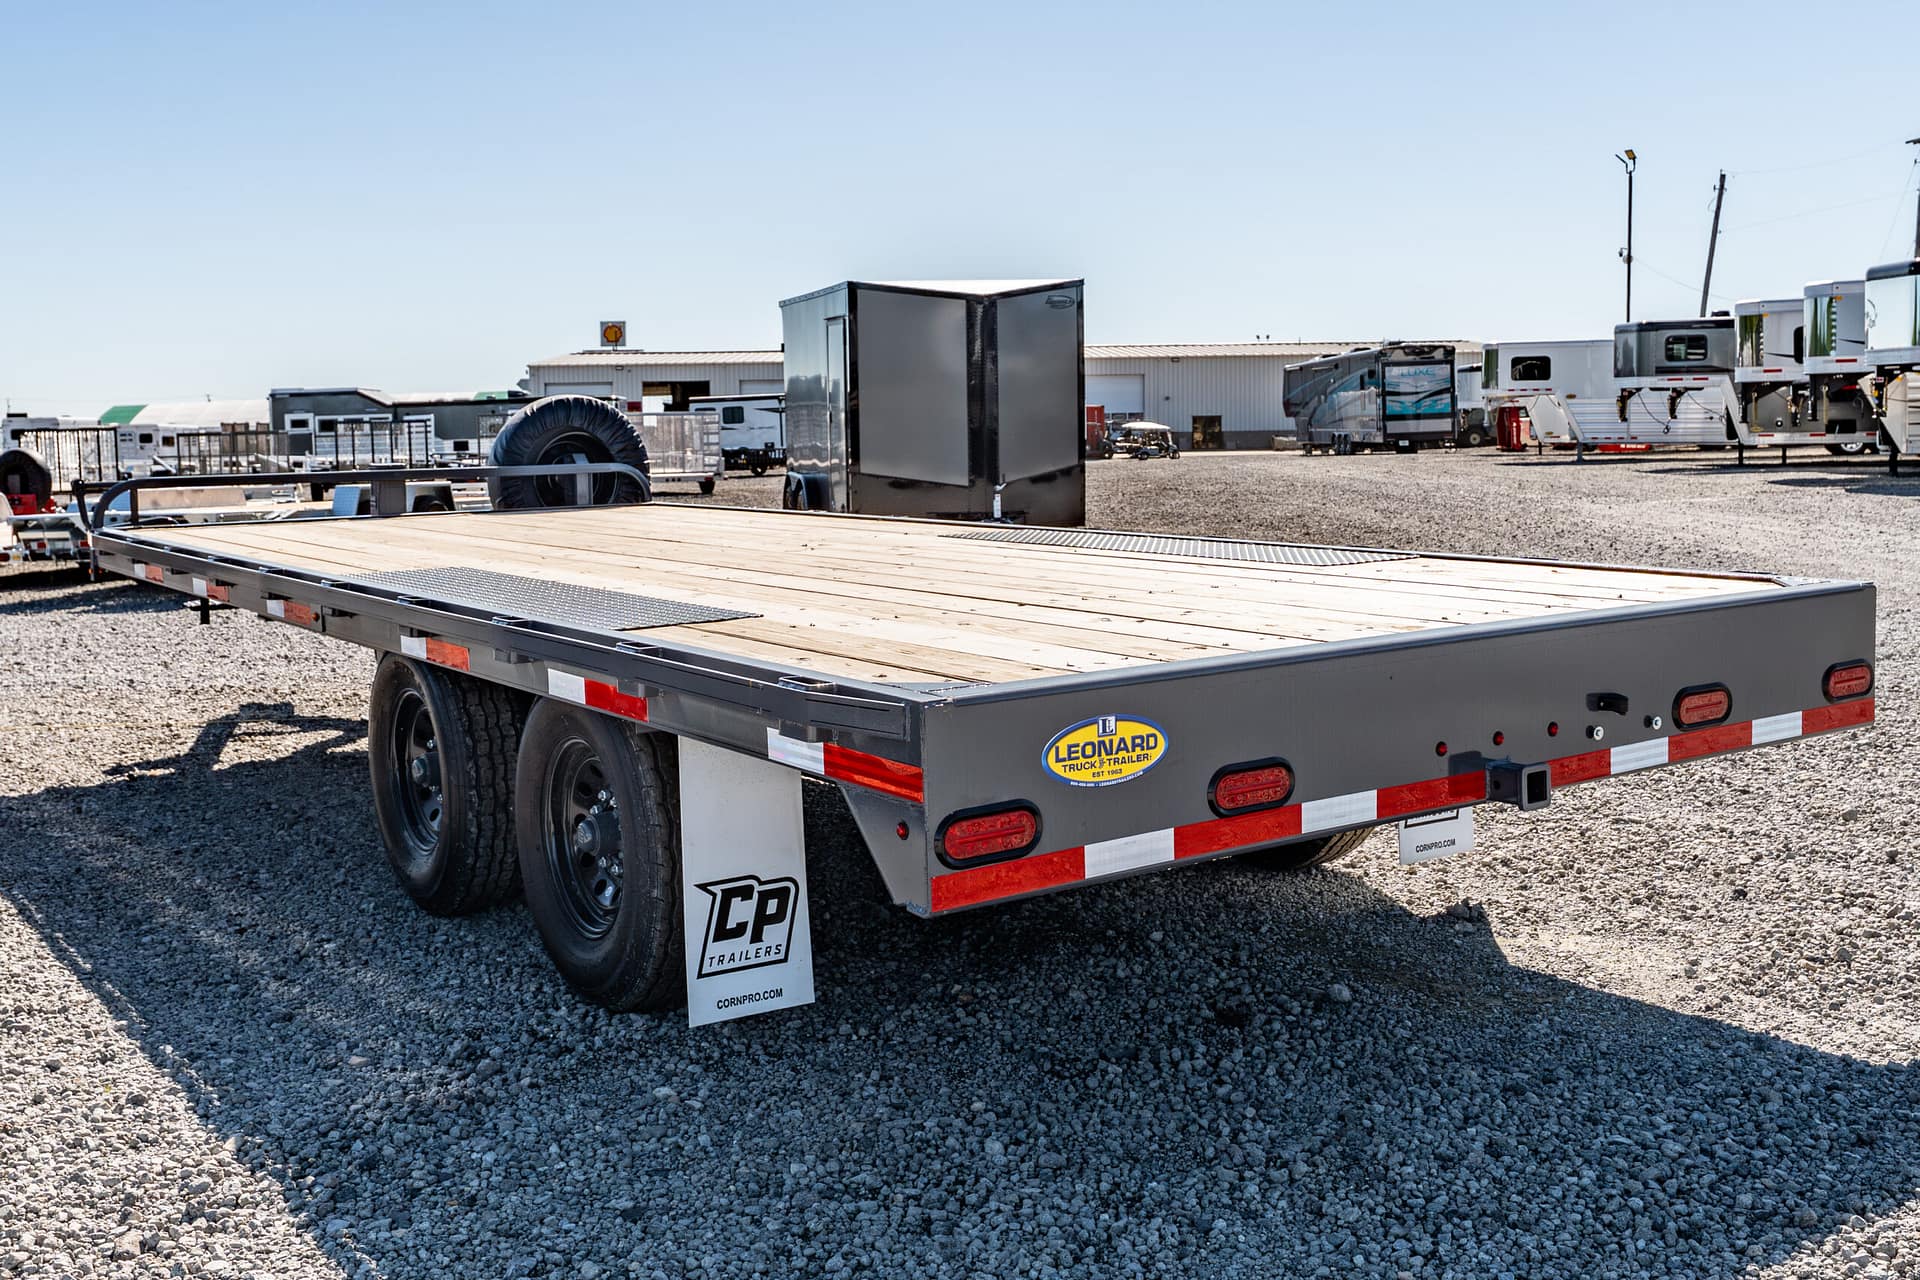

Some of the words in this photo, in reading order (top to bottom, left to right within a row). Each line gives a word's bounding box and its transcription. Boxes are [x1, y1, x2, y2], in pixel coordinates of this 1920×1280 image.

[1054, 733, 1158, 763] LEONARD
[1061, 760, 1097, 773] TRUCK
[1106, 753, 1149, 767] TRAILER
[1092, 770, 1104, 778] EST
[1415, 838, 1456, 853] CORNPRO.COM
[712, 884, 791, 944] CP
[708, 944, 782, 968] TRAILERS
[716, 987, 783, 1010] CORNPRO.COM
